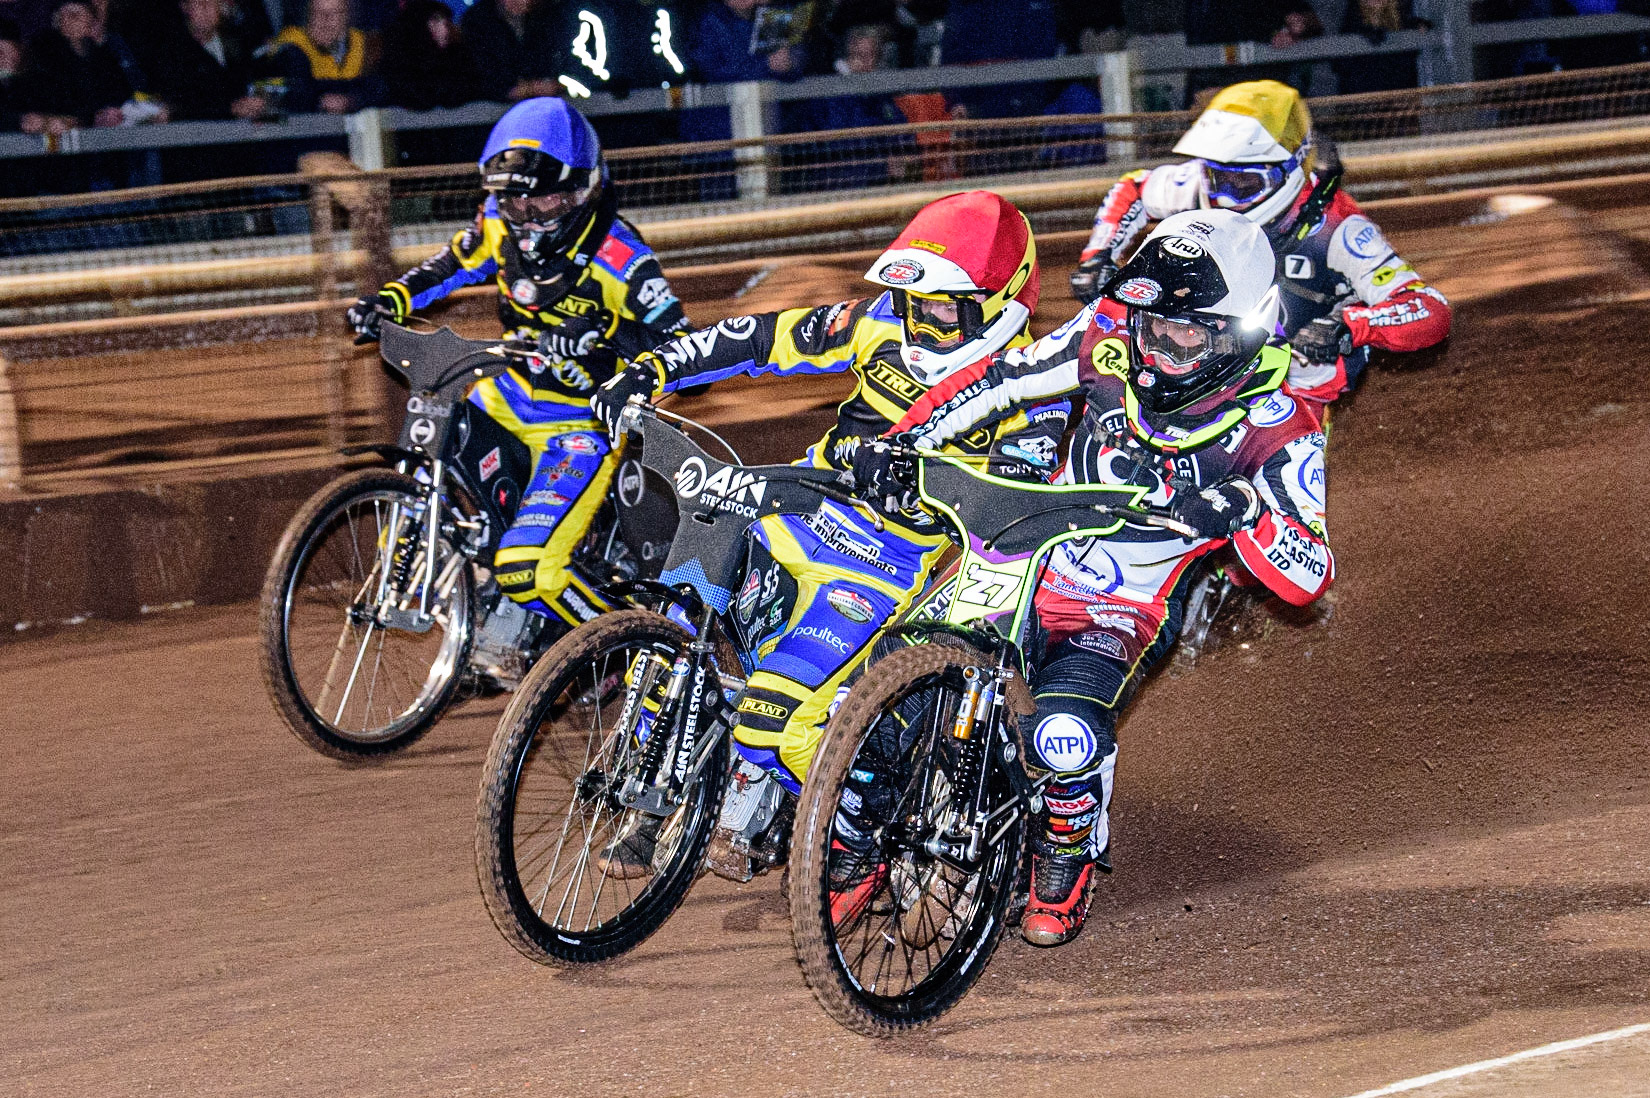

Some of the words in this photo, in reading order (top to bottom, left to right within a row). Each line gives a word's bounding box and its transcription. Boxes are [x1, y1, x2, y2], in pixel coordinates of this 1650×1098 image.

[1170, 237, 1201, 257] Arai
[1292, 257, 1306, 275] 7
[1121, 282, 1156, 299] STS
[877, 365, 920, 398] TRU
[703, 465, 768, 507] AIN
[813, 523, 895, 576] improvements
[1267, 548, 1291, 571] LTD
[957, 563, 1024, 609] 27
[1052, 575, 1097, 598] Tankers
[791, 626, 850, 655] poultec
[744, 700, 784, 716] PLANT
[674, 748, 691, 784] AIN
[684, 667, 706, 752] STEELSTOCK
[1043, 736, 1085, 755] ATPI
[1046, 795, 1093, 810] NGK
